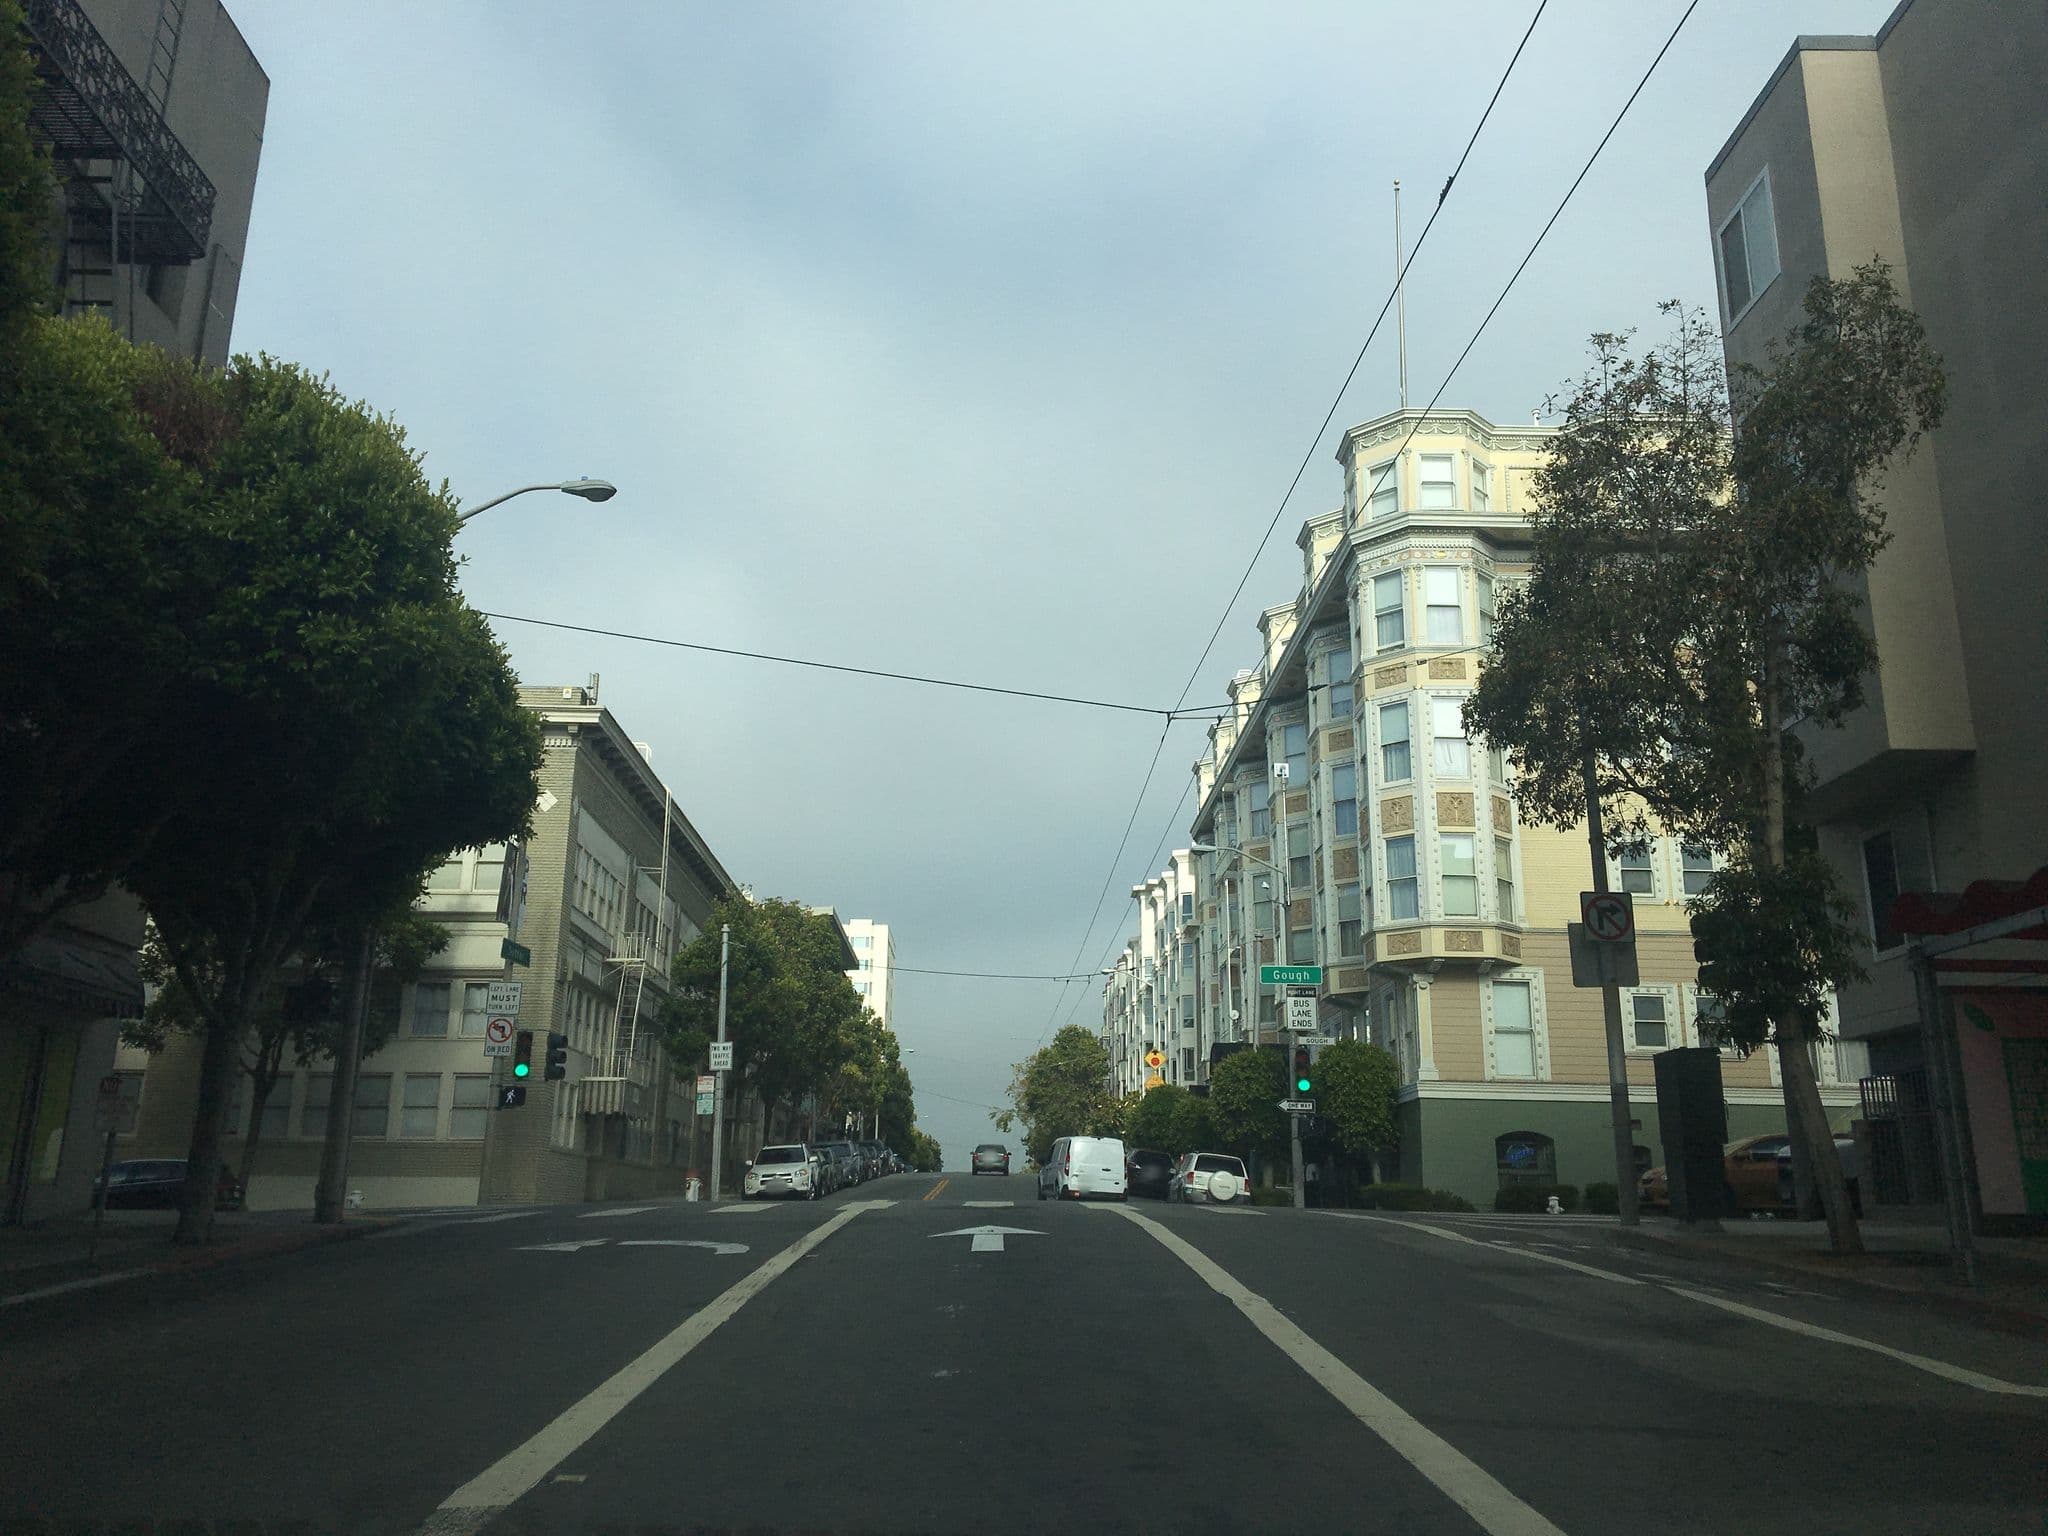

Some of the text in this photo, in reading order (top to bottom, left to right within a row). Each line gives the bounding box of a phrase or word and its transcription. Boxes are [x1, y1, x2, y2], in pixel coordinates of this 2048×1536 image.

[1273, 970, 1310, 982] Gough
[491, 994, 518, 1002] MUST
[1291, 1010, 1312, 1018] LANE
